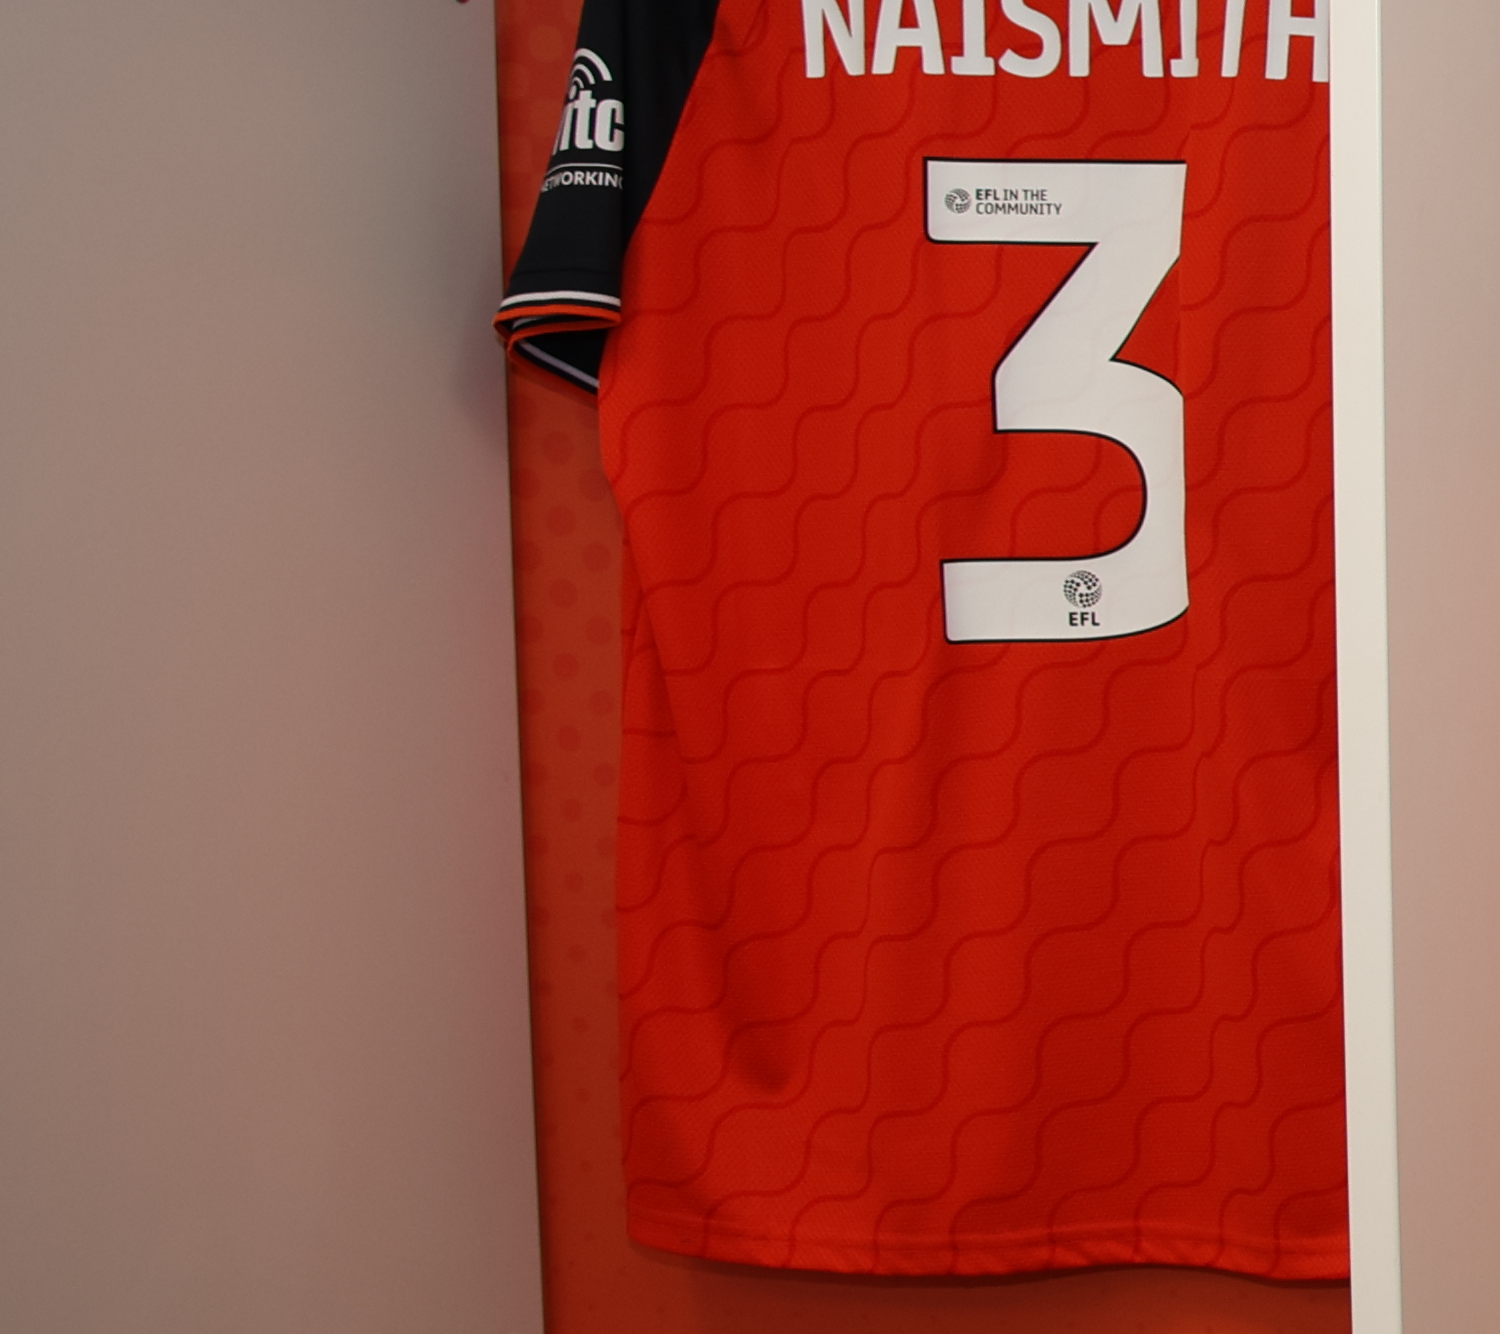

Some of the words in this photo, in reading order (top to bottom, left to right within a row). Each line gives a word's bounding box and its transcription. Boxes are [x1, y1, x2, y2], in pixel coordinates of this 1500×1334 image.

[975, 188, 1000, 201] EFL
[1003, 188, 1018, 201] IN
[1022, 188, 1047, 201] THE
[975, 202, 1063, 215] COMMUNITY
[924, 156, 1190, 645] 3
[1068, 612, 1100, 627] EFL
